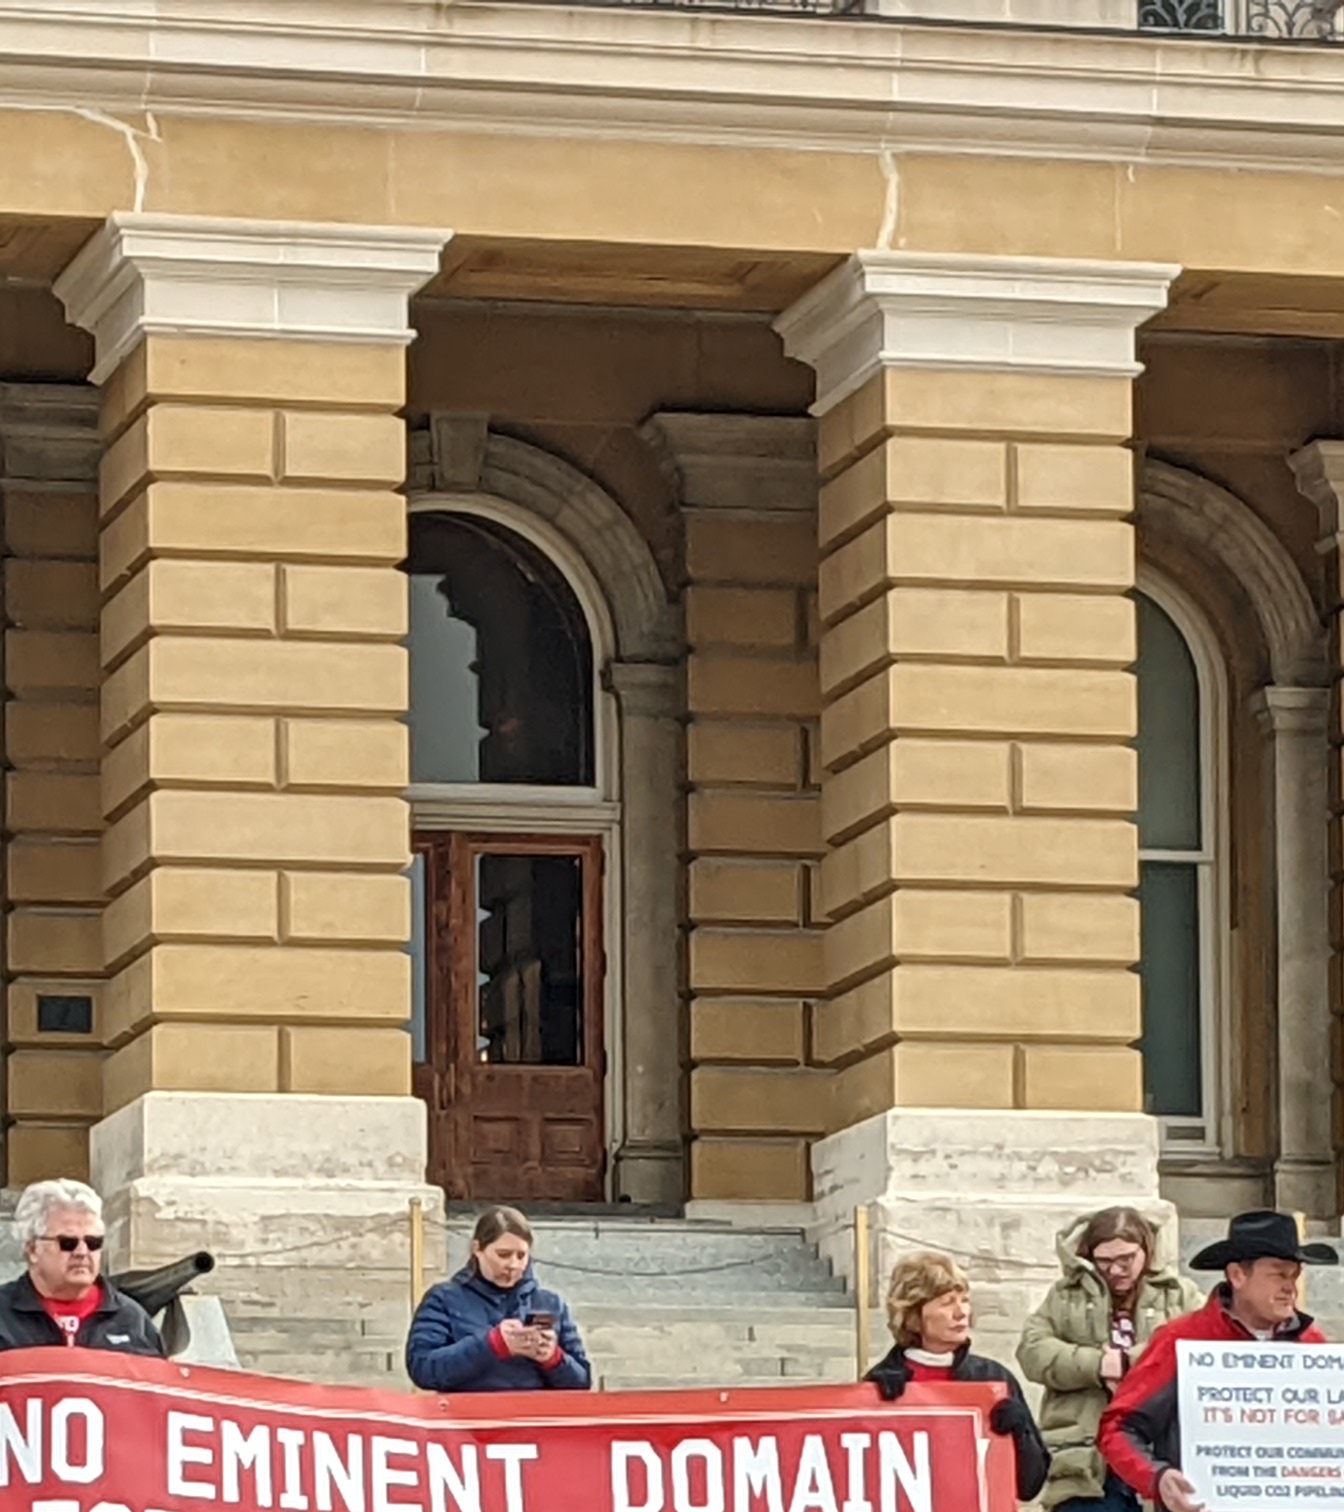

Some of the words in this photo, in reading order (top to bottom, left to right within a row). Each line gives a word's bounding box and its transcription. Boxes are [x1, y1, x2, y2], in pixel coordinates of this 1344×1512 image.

[1189, 1352, 1214, 1367] NO
[1222, 1352, 1295, 1368] EMINENT
[1197, 1386, 1273, 1403] PROTECT
[1281, 1388, 1319, 1404] OUR
[1203, 1407, 1233, 1423] IT'S
[1240, 1408, 1276, 1423] NOT
[1284, 1409, 1319, 1424] FOR
[1196, 1445, 1251, 1457] PROTECT
[1255, 1447, 1284, 1458] OUR
[1212, 1465, 1249, 1477] FROM
[1253, 1466, 1276, 1477] THE
[1281, 1466, 1341, 1478] DANGERS
[1216, 1485, 1262, 1498] LIQUID
